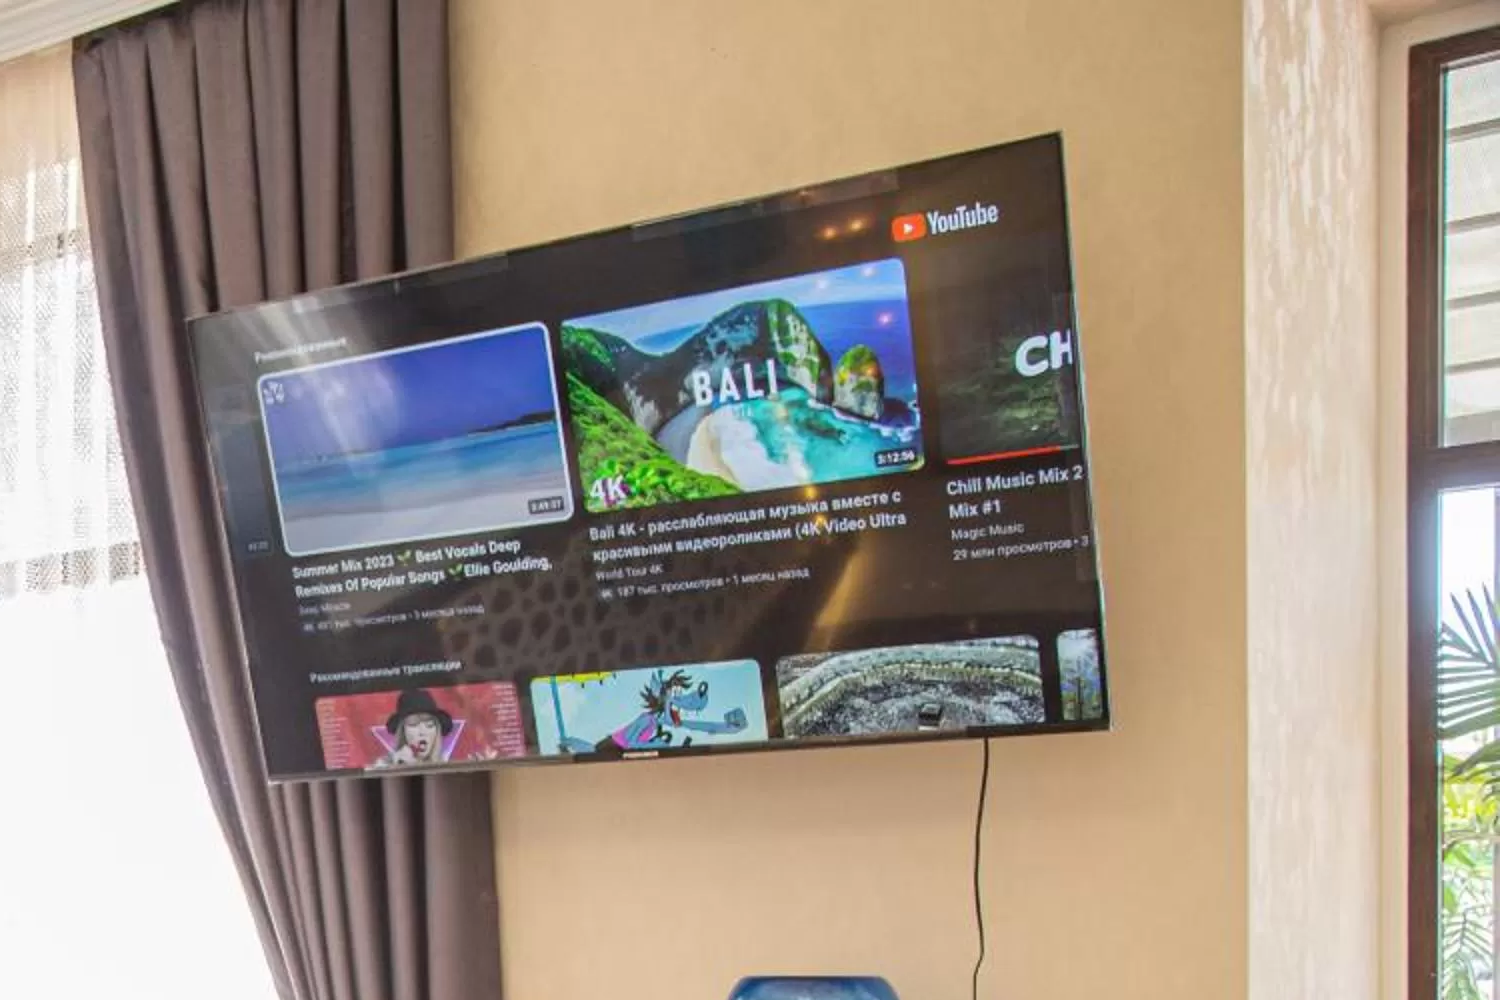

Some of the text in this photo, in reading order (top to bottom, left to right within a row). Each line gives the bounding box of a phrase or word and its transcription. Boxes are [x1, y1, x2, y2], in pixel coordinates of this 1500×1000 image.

[927, 202, 999, 234] YouTube
[692, 358, 778, 408] BALI
[590, 475, 626, 499] 4K
[946, 464, 1084, 495] Chill Music Mix 2
[589, 525, 615, 541] Bali
[617, 522, 636, 537] 4K
[647, 509, 766, 538] расслабляющая
[769, 502, 829, 520] музыка
[832, 493, 889, 511] вместе
[949, 500, 1001, 519] Mix #1
[593, 541, 673, 564] красивыми
[675, 527, 791, 552] видеороликами
[823, 517, 866, 535] Video
[869, 512, 907, 529] Ultra
[951, 523, 1025, 541] Magic Music
[415, 549, 443, 563] Best
[444, 542, 487, 559] Vocals
[488, 540, 521, 555] Deep
[997, 539, 1073, 557] просмотров
[295, 583, 343, 598] Remixes
[345, 577, 359, 591] Of
[361, 573, 406, 591] Popular
[408, 570, 445, 585] Songs
[463, 562, 491, 577] Ellie
